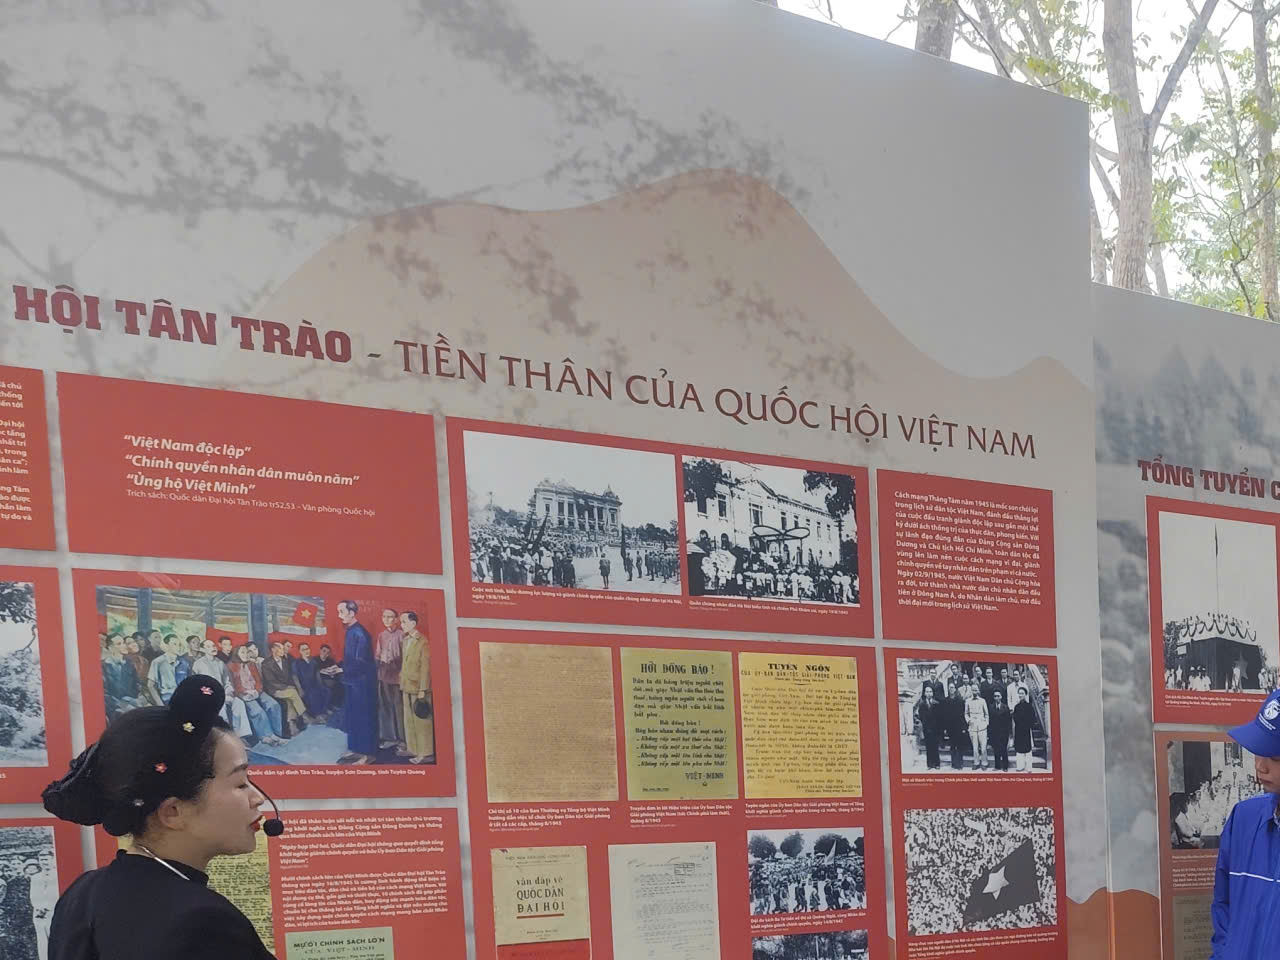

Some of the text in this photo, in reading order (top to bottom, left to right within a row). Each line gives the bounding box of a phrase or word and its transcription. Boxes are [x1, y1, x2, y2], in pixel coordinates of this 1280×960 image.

[13, 285, 101, 333] HỘI
[116, 299, 217, 345] TÂN
[231, 319, 352, 363] TRÀO
[394, 332, 487, 383] TIỀN
[499, 357, 612, 400] THÂN
[626, 368, 704, 412] CỦA
[715, 386, 820, 428] QUỐC
[830, 403, 888, 443] HỘI
[898, 413, 957, 452] VIỆT
[967, 425, 1036, 459] NAM
[161, 439, 193, 451] Nam
[196, 442, 221, 455] độc
[175, 460, 217, 478] quyền
[220, 463, 254, 476] nhân
[257, 466, 282, 479] dân
[284, 470, 322, 482] muôn
[1137, 454, 1194, 488] TỔNG
[1200, 467, 1265, 498] TUYỂN
[164, 477, 182, 492] hộ
[185, 477, 211, 493] Việt
[975, 500, 989, 508] 1945
